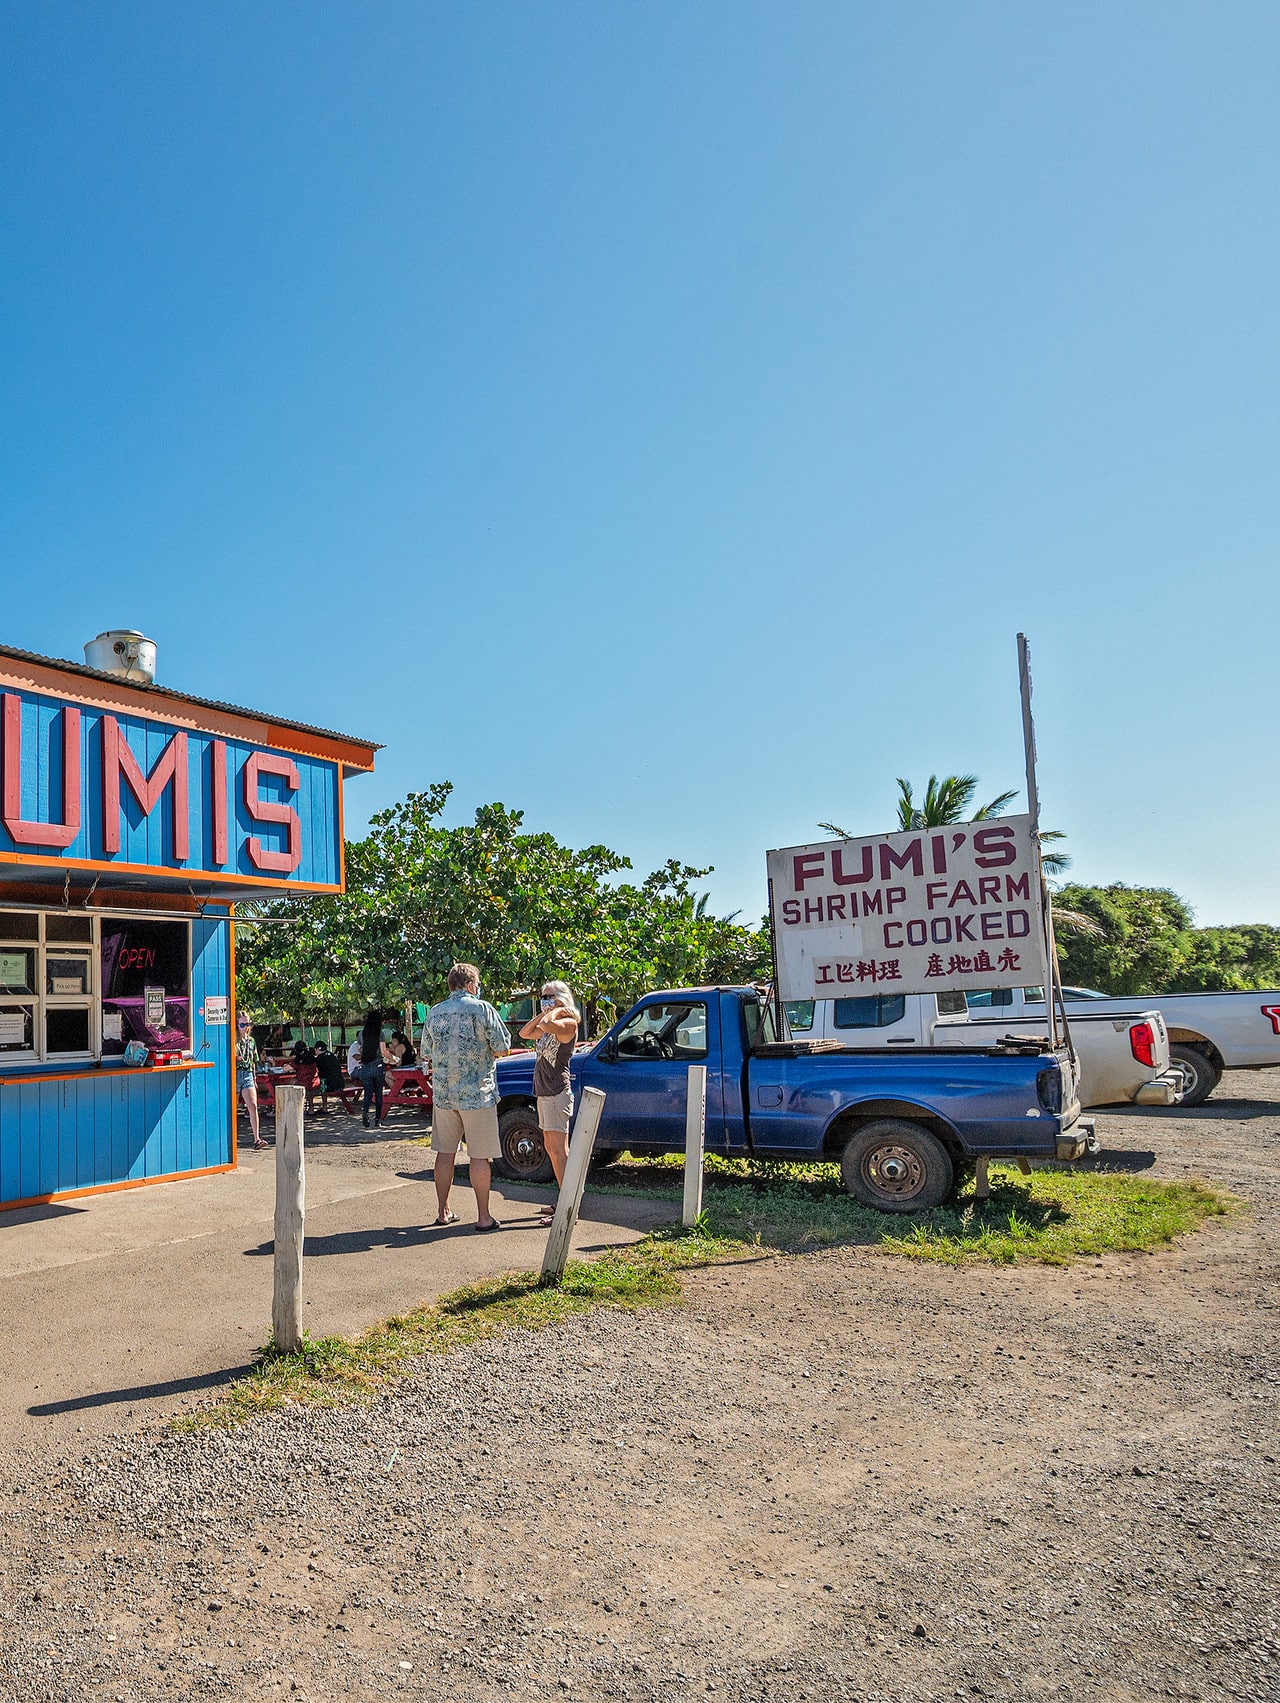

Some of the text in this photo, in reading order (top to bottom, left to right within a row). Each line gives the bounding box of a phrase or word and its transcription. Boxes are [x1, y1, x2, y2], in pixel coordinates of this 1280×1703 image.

[792, 826, 1018, 892] FUMI'S
[782, 871, 1031, 926] SHRIMP FARM
[883, 909, 1031, 949] COOKED
[119, 947, 156, 971] OPEN
[924, 946, 1023, 979] 産地直売
